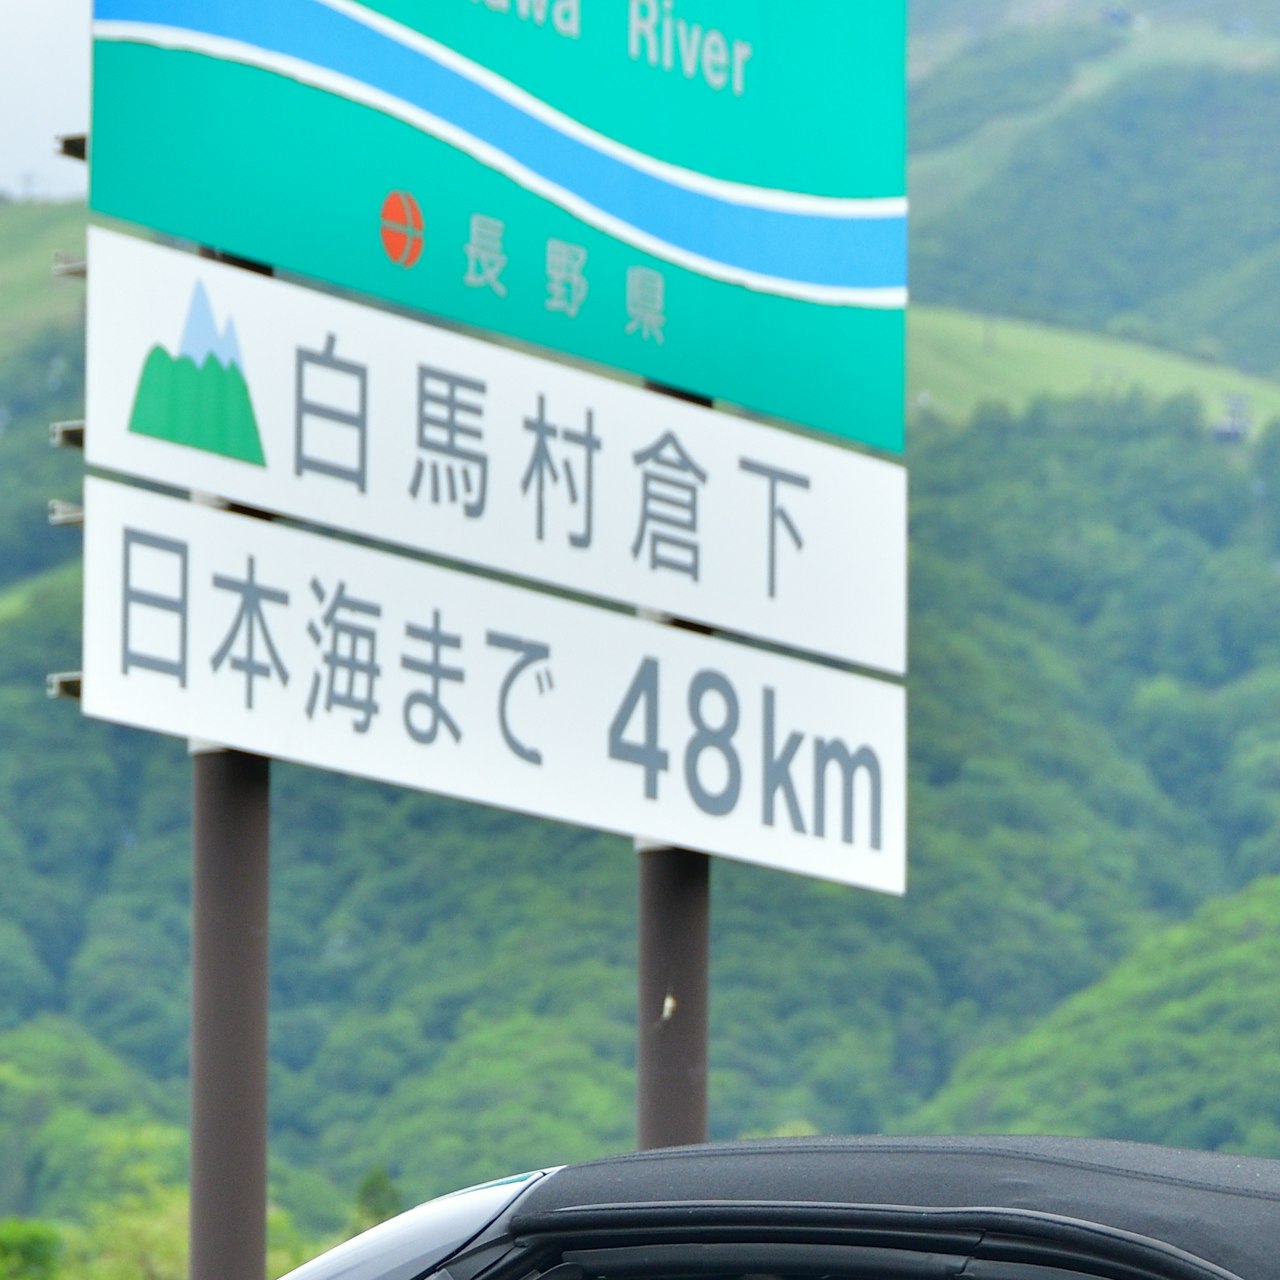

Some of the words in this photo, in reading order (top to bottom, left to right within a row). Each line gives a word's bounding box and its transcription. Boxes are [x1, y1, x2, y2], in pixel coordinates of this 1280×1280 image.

[628, 0, 752, 97] River
[463, 212, 667, 346] 長野県
[294, 334, 811, 599] 白馬村倉下
[121, 527, 554, 766] 日本海まで
[607, 655, 883, 851] 48km
